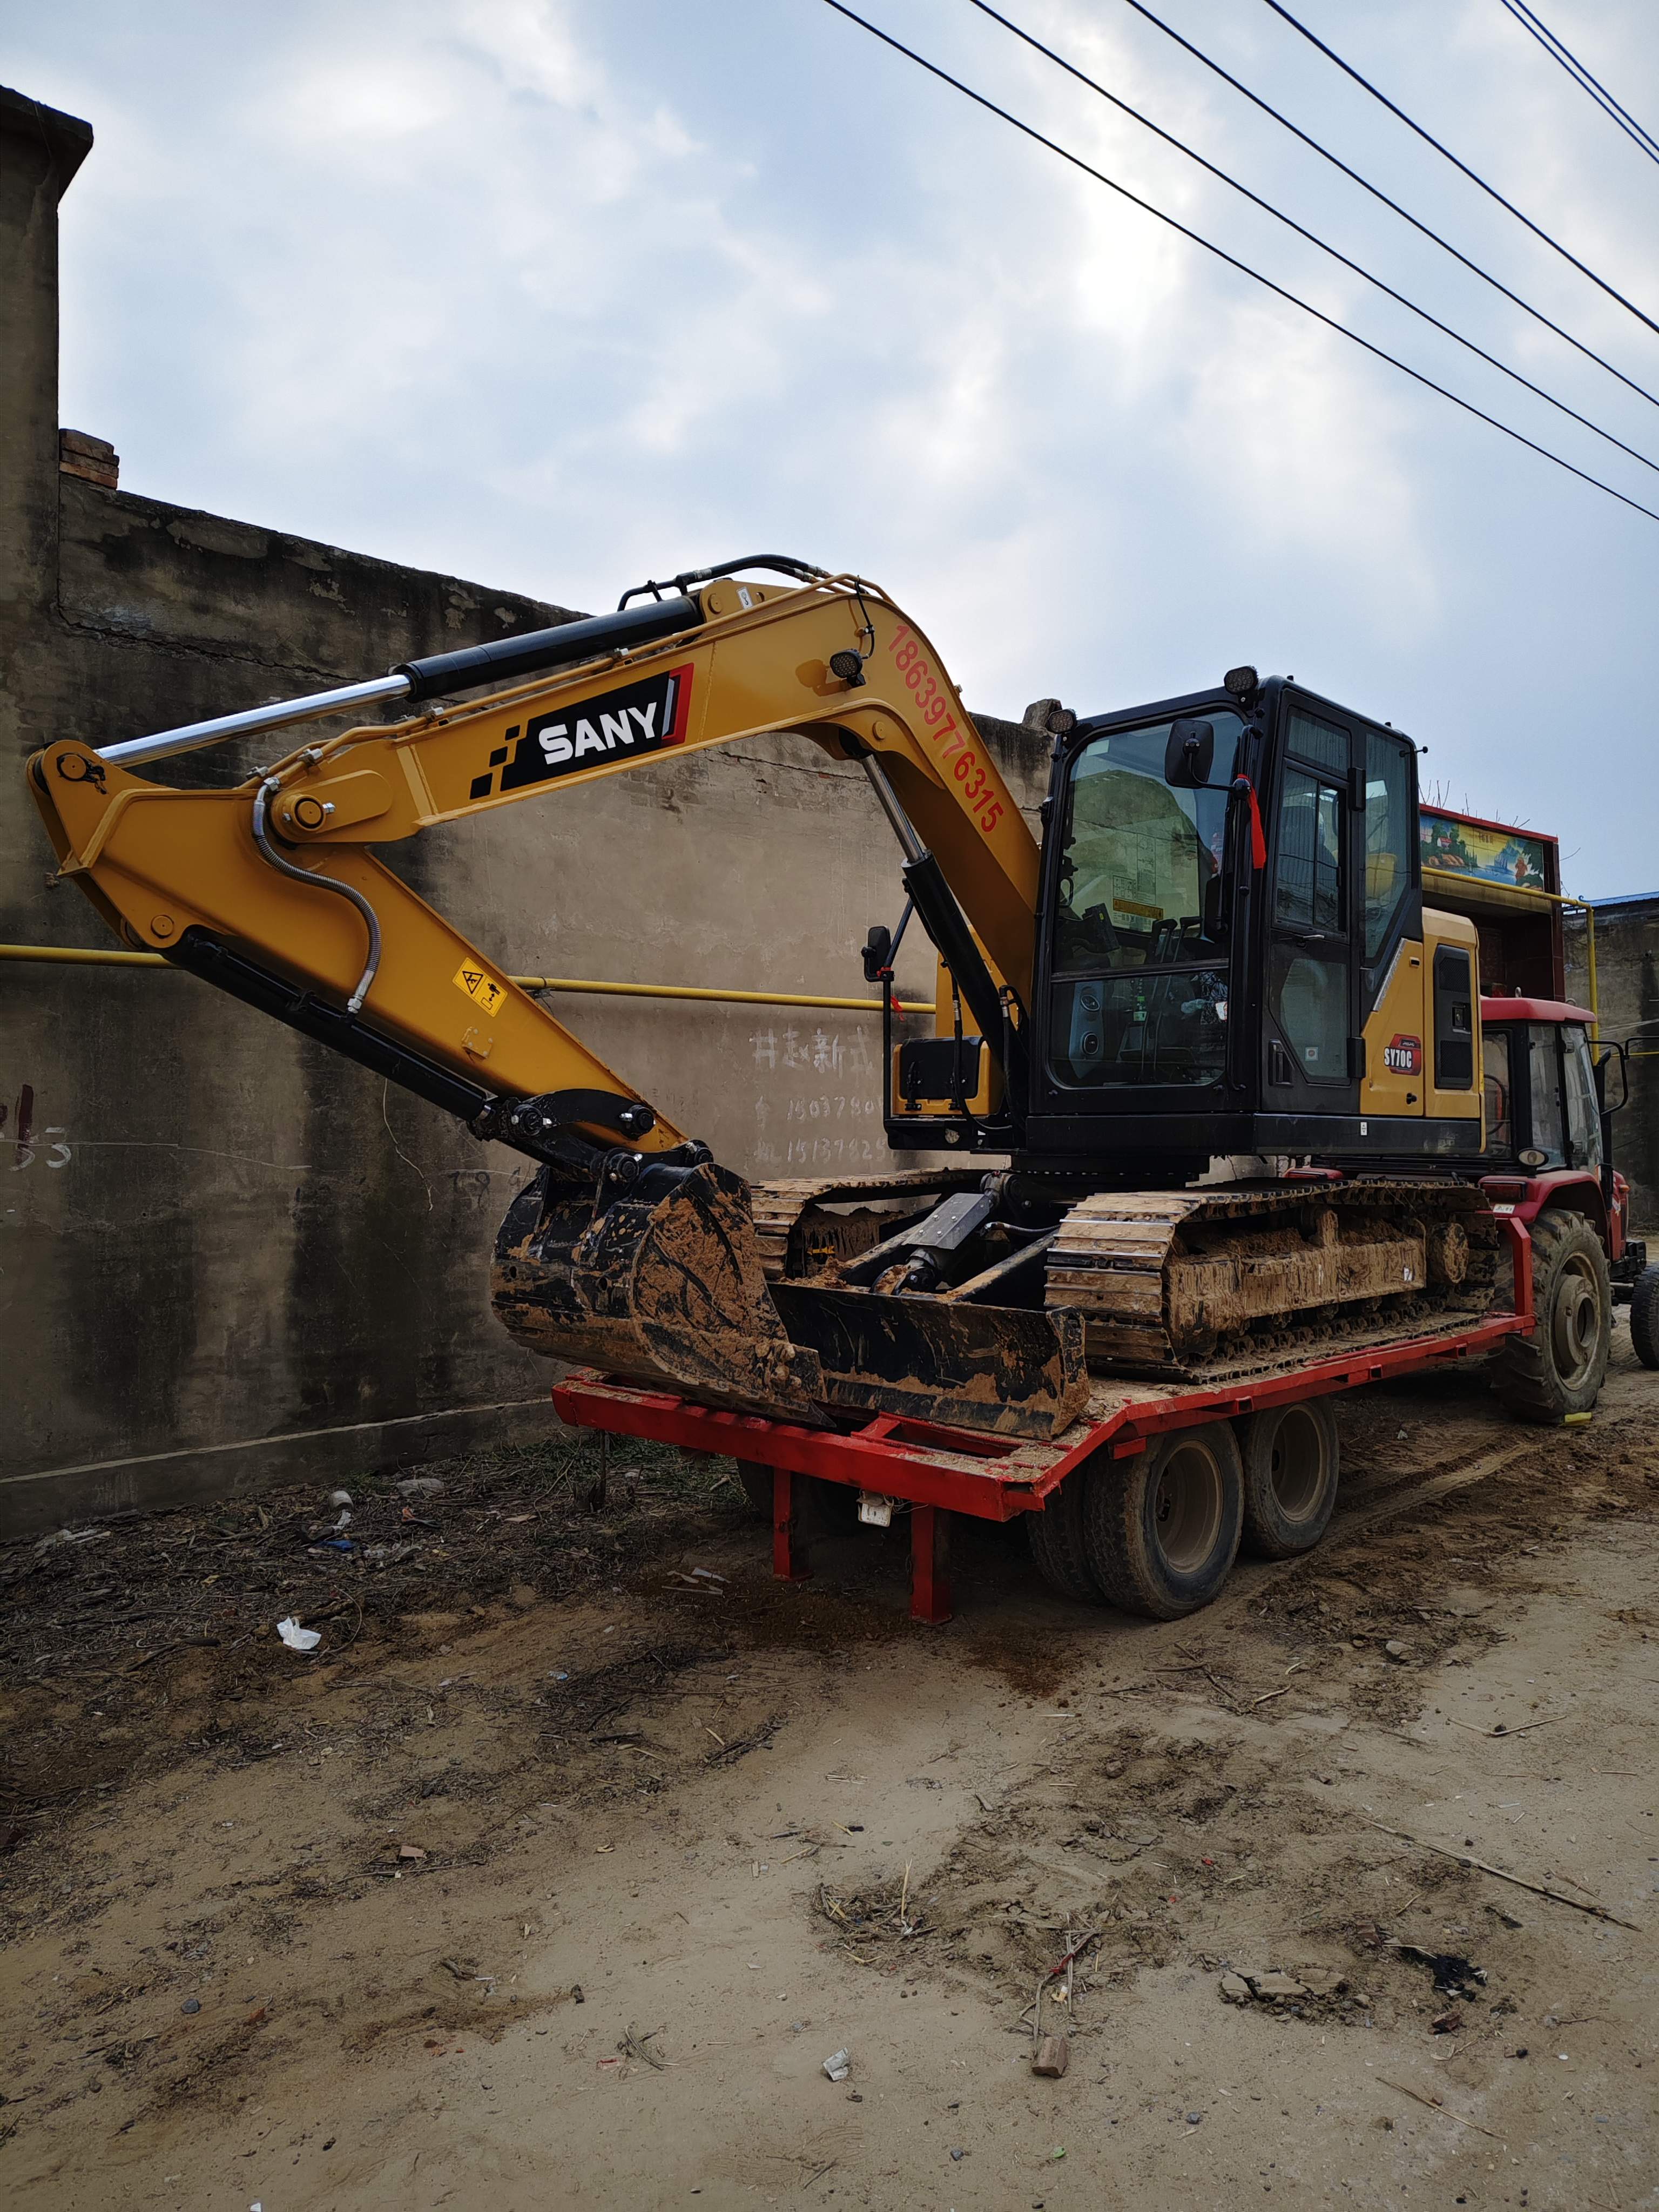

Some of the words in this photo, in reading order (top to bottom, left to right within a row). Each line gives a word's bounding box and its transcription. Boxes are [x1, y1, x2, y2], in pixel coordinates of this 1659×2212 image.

[538, 702, 657, 765] SANY
[889, 624, 1004, 832] 18639776315
[1384, 1048, 1412, 1068] SY70C
